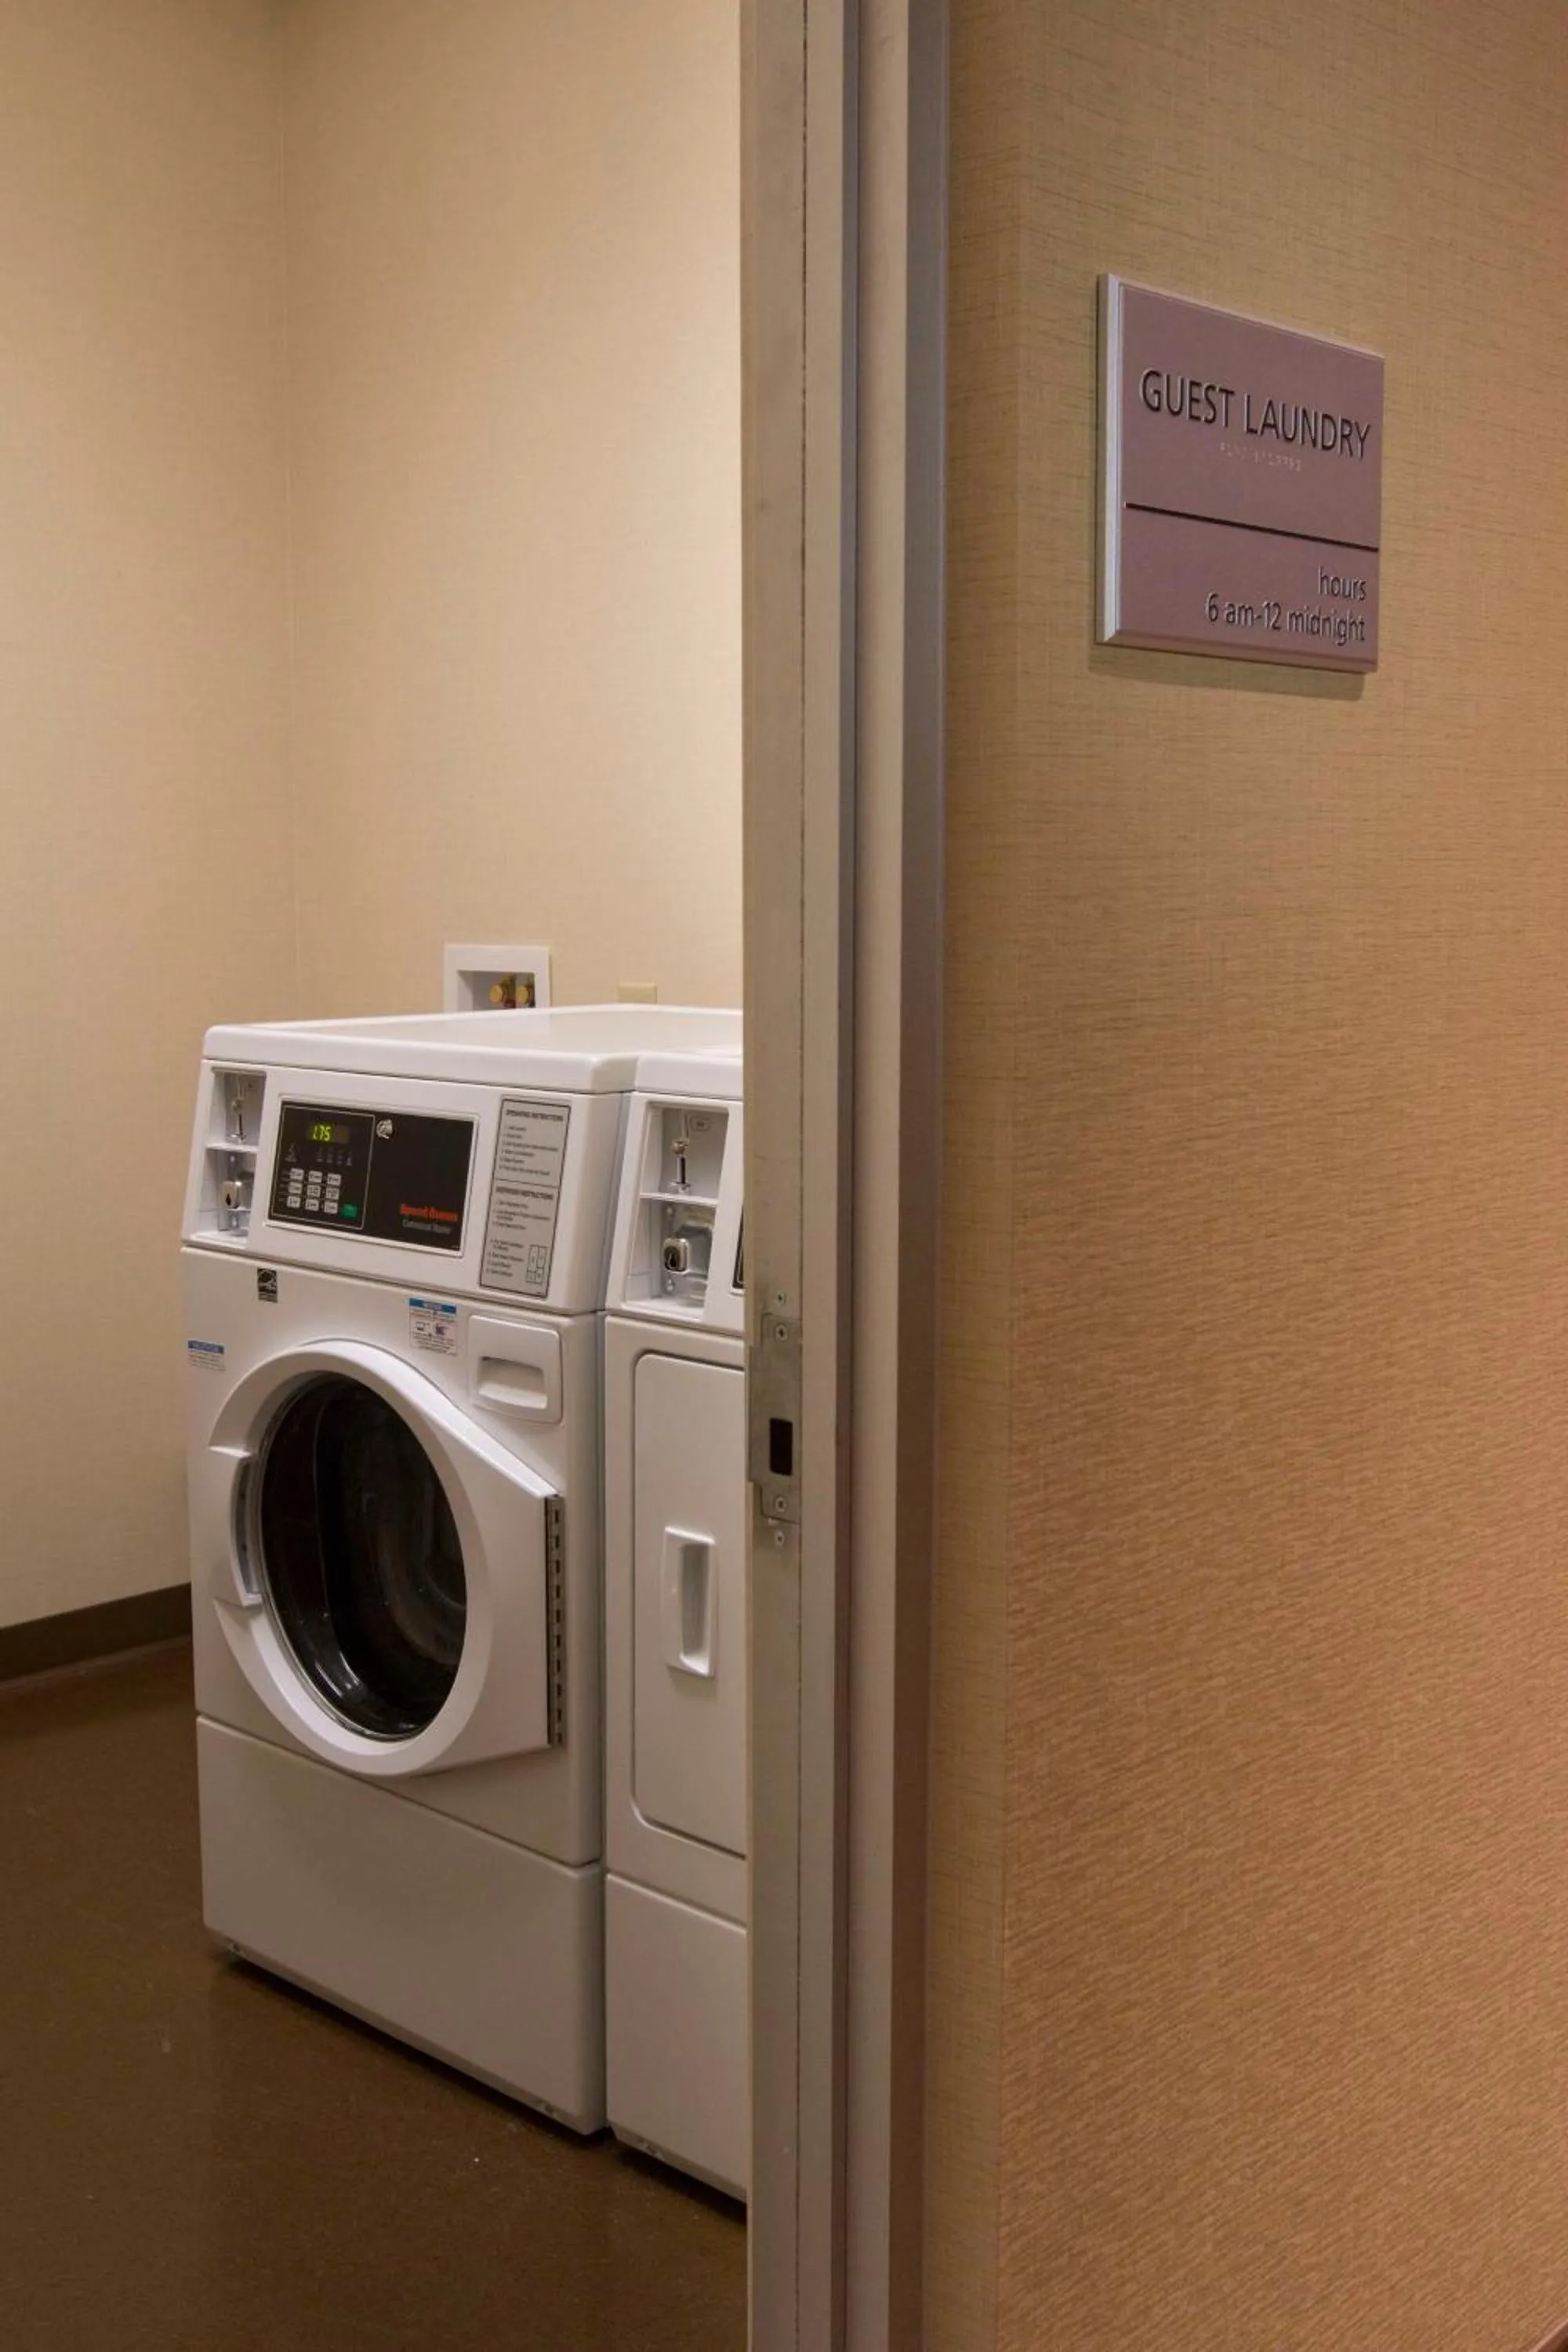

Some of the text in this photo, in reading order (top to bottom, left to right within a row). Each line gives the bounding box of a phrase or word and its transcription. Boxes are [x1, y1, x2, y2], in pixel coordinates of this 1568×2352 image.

[1140, 367, 1372, 459] GUEST LAUNDRY
[1318, 565, 1367, 602] hours
[1205, 592, 1367, 647] 6 am-12 midnight
